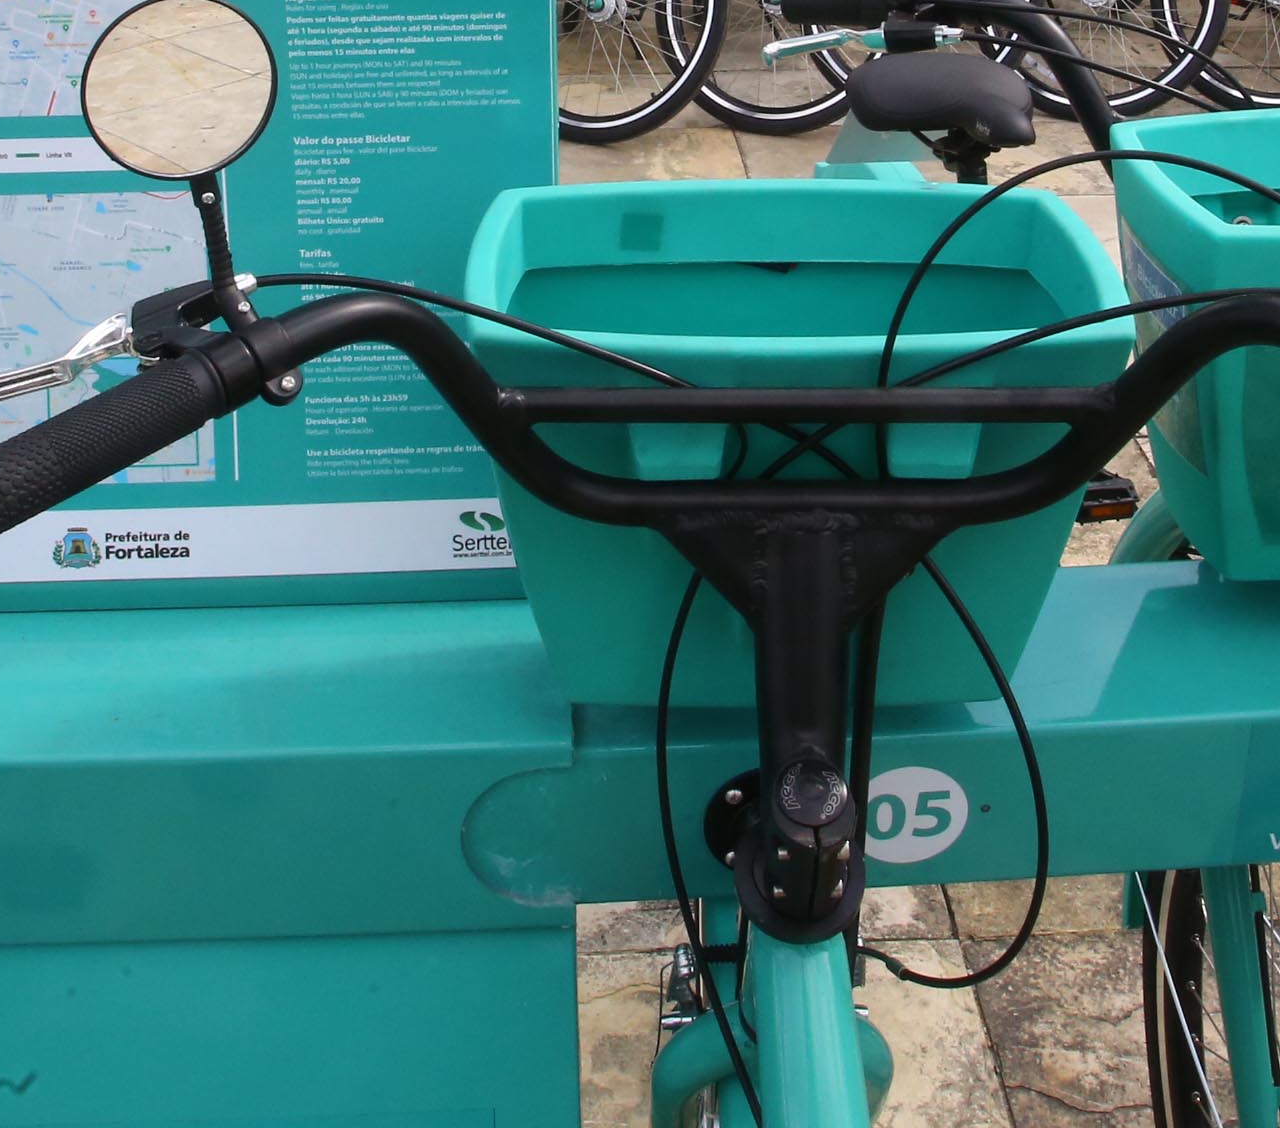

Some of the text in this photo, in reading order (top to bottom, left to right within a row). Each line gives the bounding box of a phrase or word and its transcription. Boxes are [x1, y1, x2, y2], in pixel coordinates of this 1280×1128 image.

[294, 135, 410, 146] Valor do passe Bicicletar
[299, 249, 331, 258] Tarifas
[305, 396, 342, 405] Funciona
[307, 449, 321, 457] Use
[330, 448, 364, 456] bicicleta
[366, 446, 416, 456] respeitando
[427, 446, 452, 455] regras
[466, 444, 486, 452] trân
[105, 530, 190, 546] Prefeitura de
[106, 543, 191, 561] Fortaleza
[868, 790, 952, 840] 05
